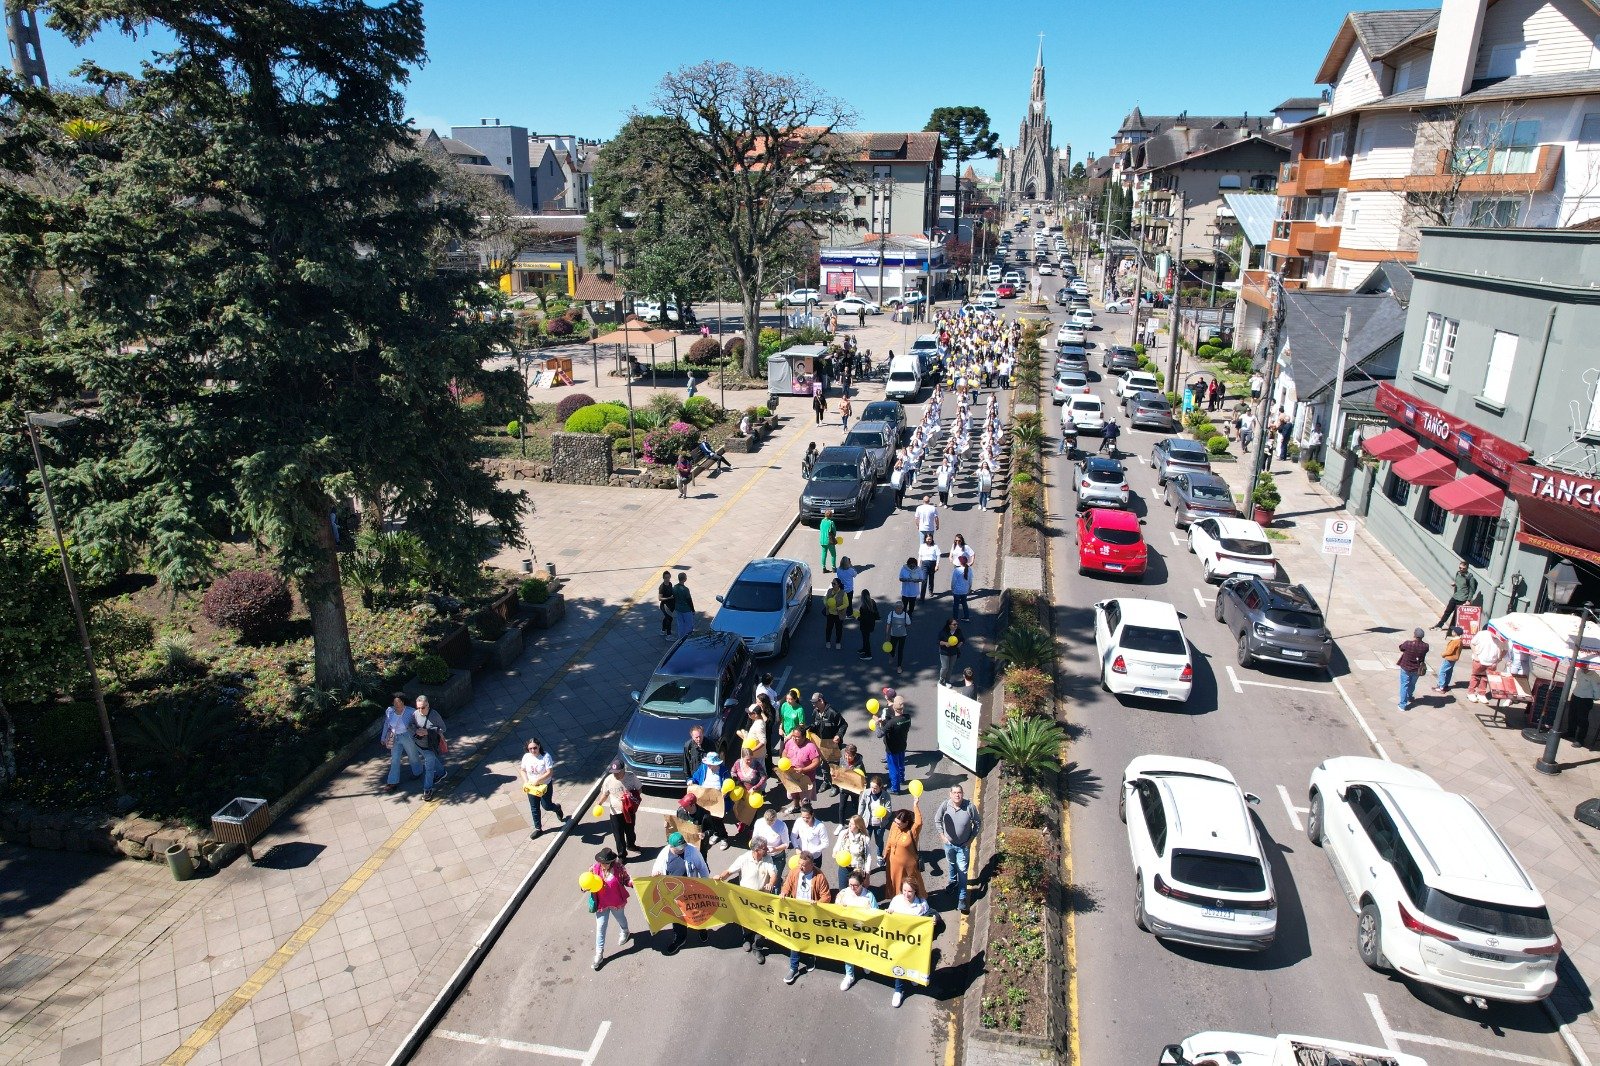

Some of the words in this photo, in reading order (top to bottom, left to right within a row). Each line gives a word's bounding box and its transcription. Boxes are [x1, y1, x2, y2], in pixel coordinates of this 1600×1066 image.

[1422, 411, 1450, 440] TANGO
[1336, 523, 1344, 532] E
[1527, 537, 1581, 556] RESTAURANTE
[944, 709, 972, 730] CREAS
[683, 893, 726, 902] SETEMBRO
[685, 901, 728, 911] AMARELO
[738, 896, 775, 915] Você
[778, 911, 808, 924] não
[812, 918, 848, 930] está
[852, 923, 922, 946] sozinho!
[765, 918, 811, 941] Todos
[815, 933, 850, 947] pela
[854, 938, 893, 961] Vida.
